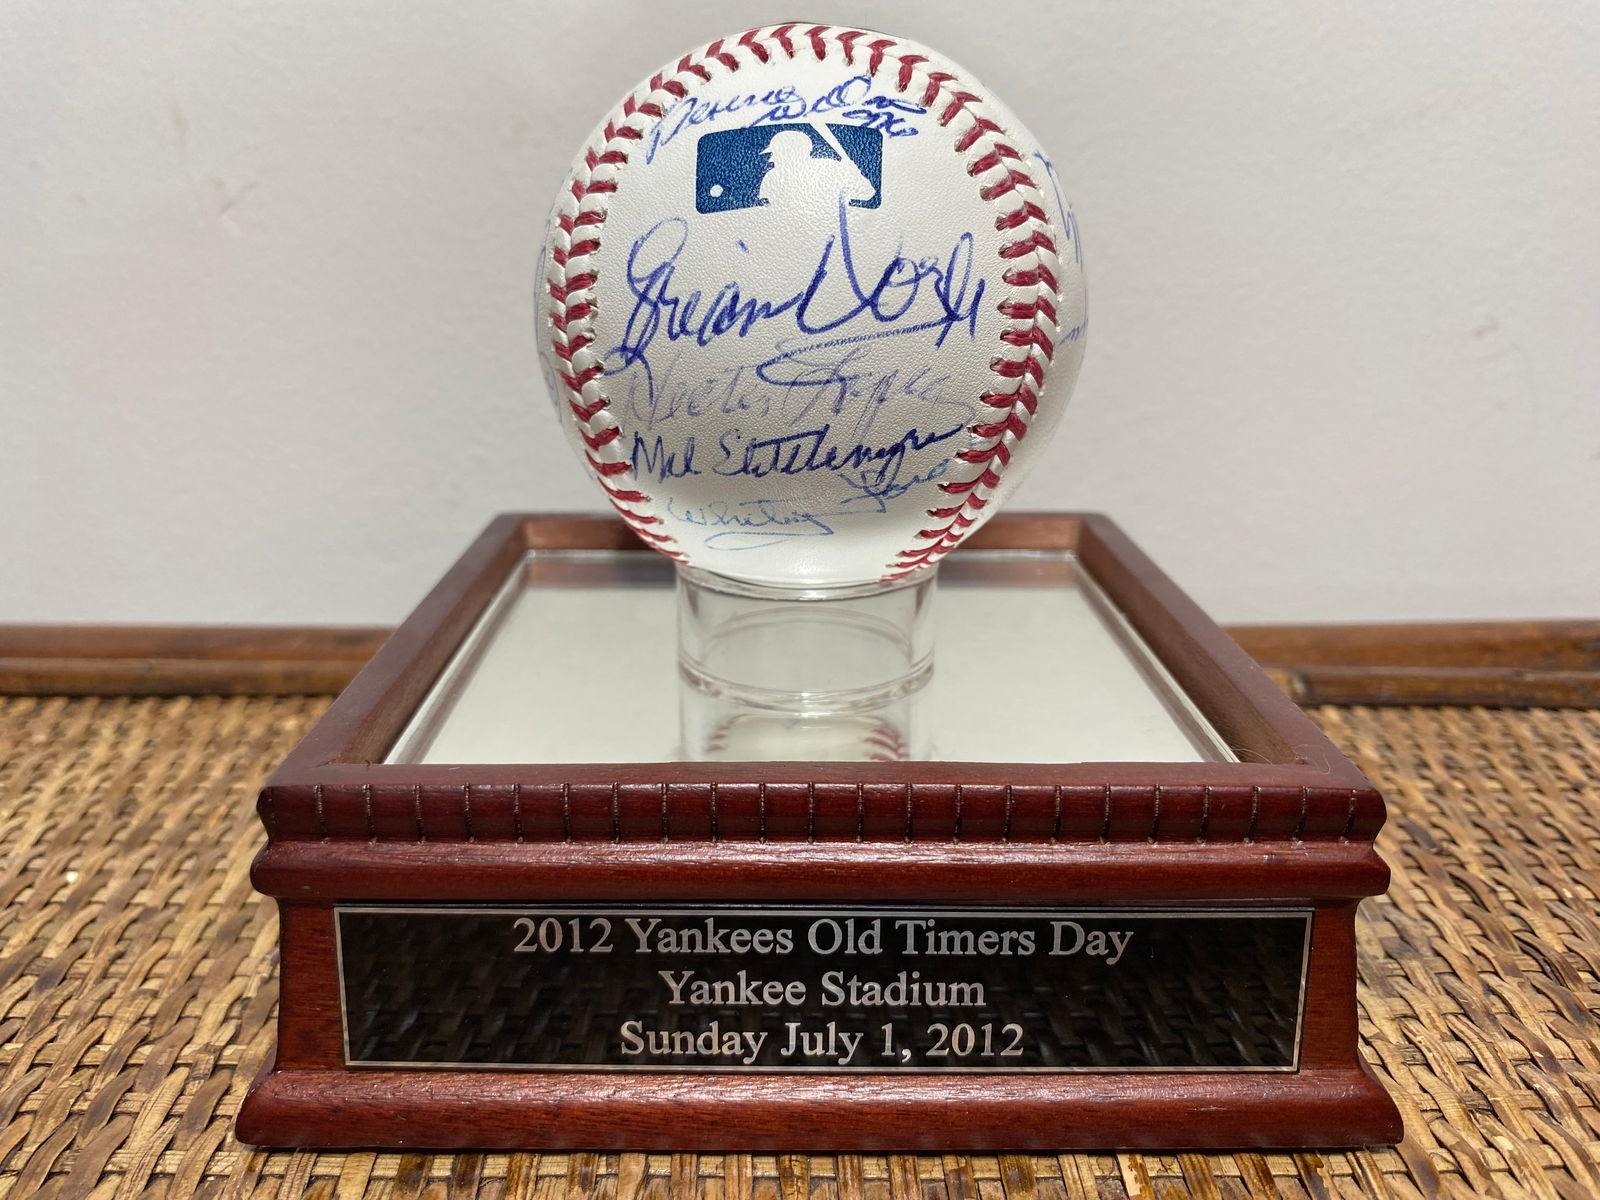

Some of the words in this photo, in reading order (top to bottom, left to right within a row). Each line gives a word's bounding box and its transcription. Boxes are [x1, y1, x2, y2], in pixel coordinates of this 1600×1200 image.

[631, 430, 702, 484] Mel
[513, 917, 614, 953] 2012
[624, 917, 794, 954] Yankees
[807, 918, 883, 955] Old
[894, 918, 1036, 956] Timers
[1048, 920, 1135, 966] Day
[658, 969, 807, 1006] Yankee
[821, 970, 987, 1007] Stadium
[620, 1020, 769, 1065] Sunday
[780, 1020, 865, 1066] July
[880, 1022, 913, 1064] 1,
[925, 1022, 1025, 1057] 2012
